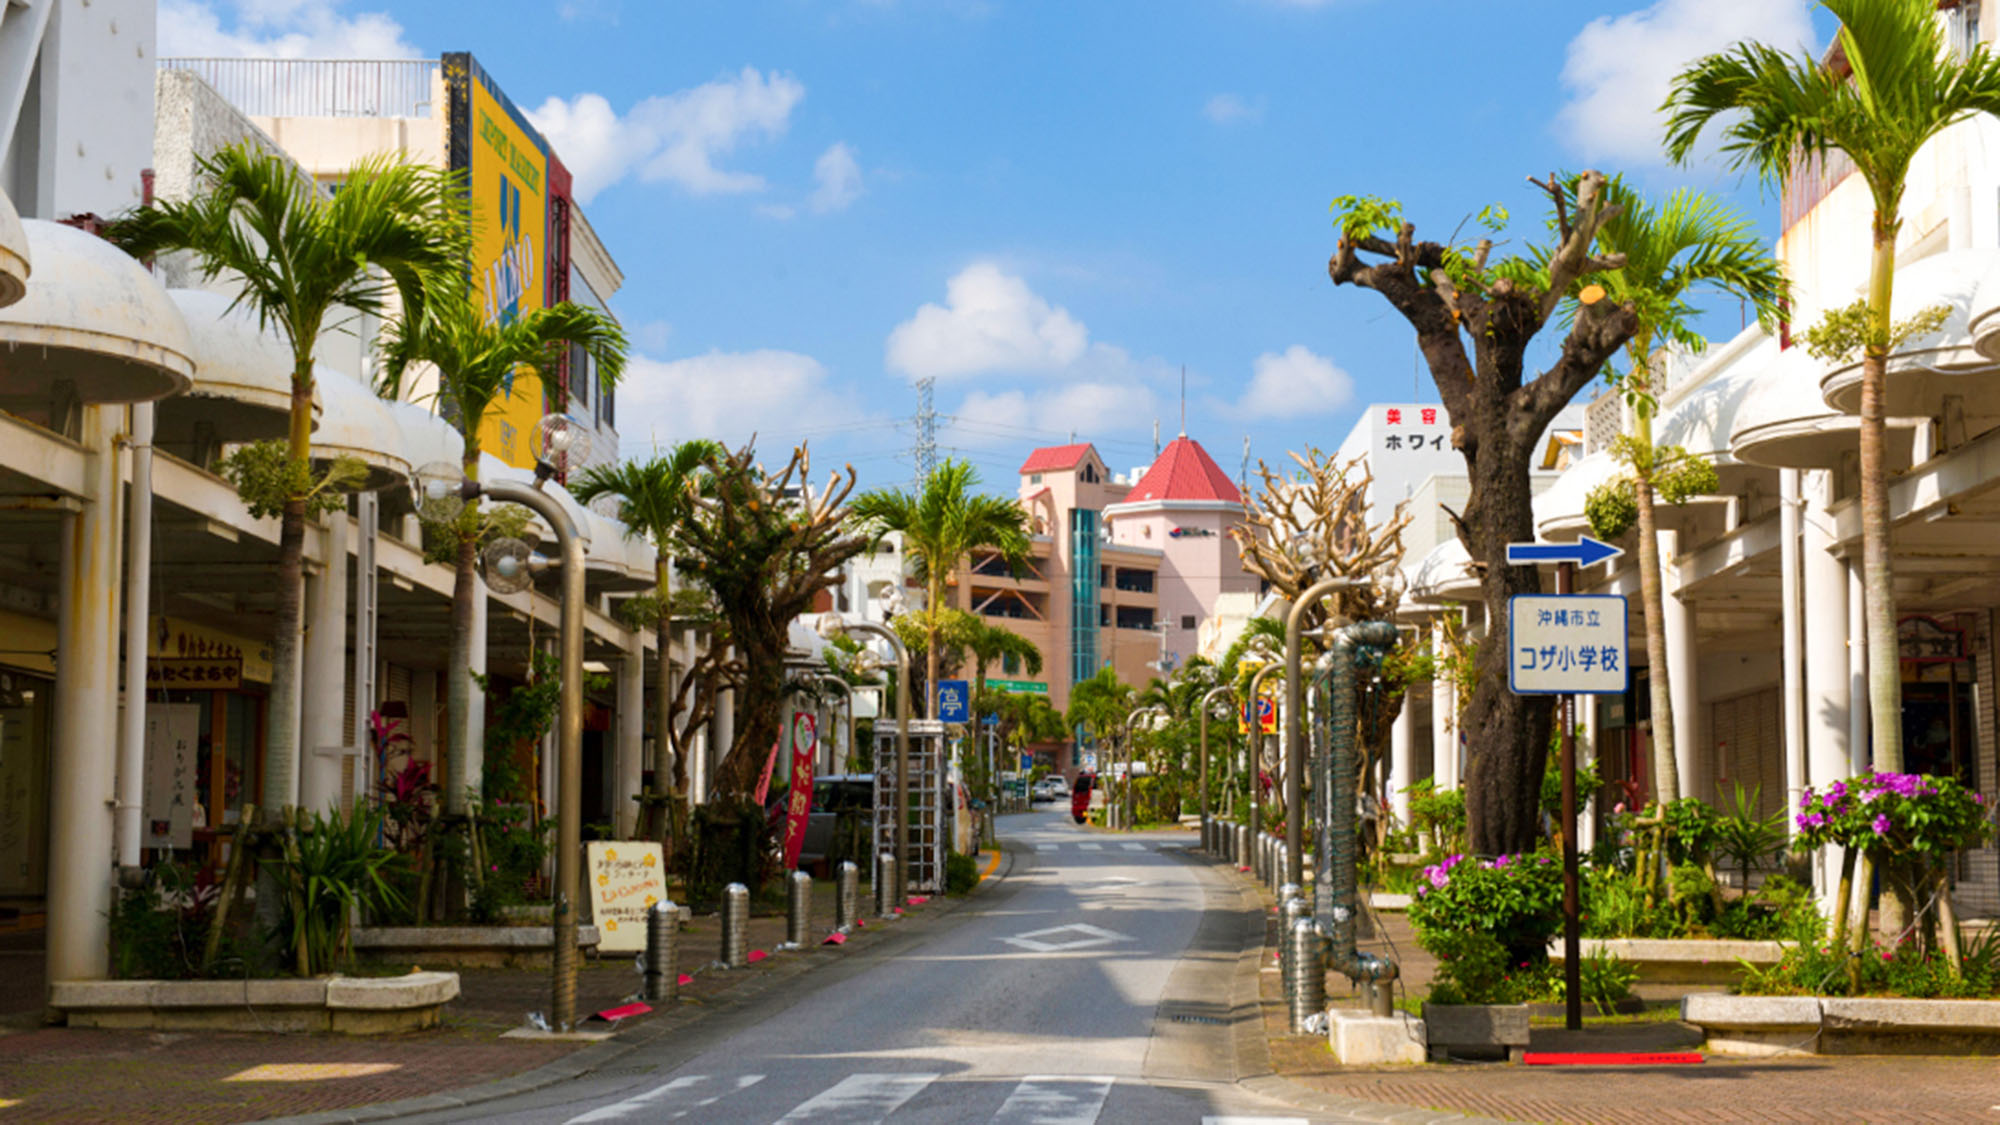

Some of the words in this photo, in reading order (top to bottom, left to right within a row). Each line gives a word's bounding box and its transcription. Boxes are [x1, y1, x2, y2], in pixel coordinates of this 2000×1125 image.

[1386, 408, 1437, 425] 美容
[1385, 434, 1456, 451] ホワイ
[1537, 608, 1601, 627] 沖縄市立
[1520, 645, 1619, 672] コザ小学校
